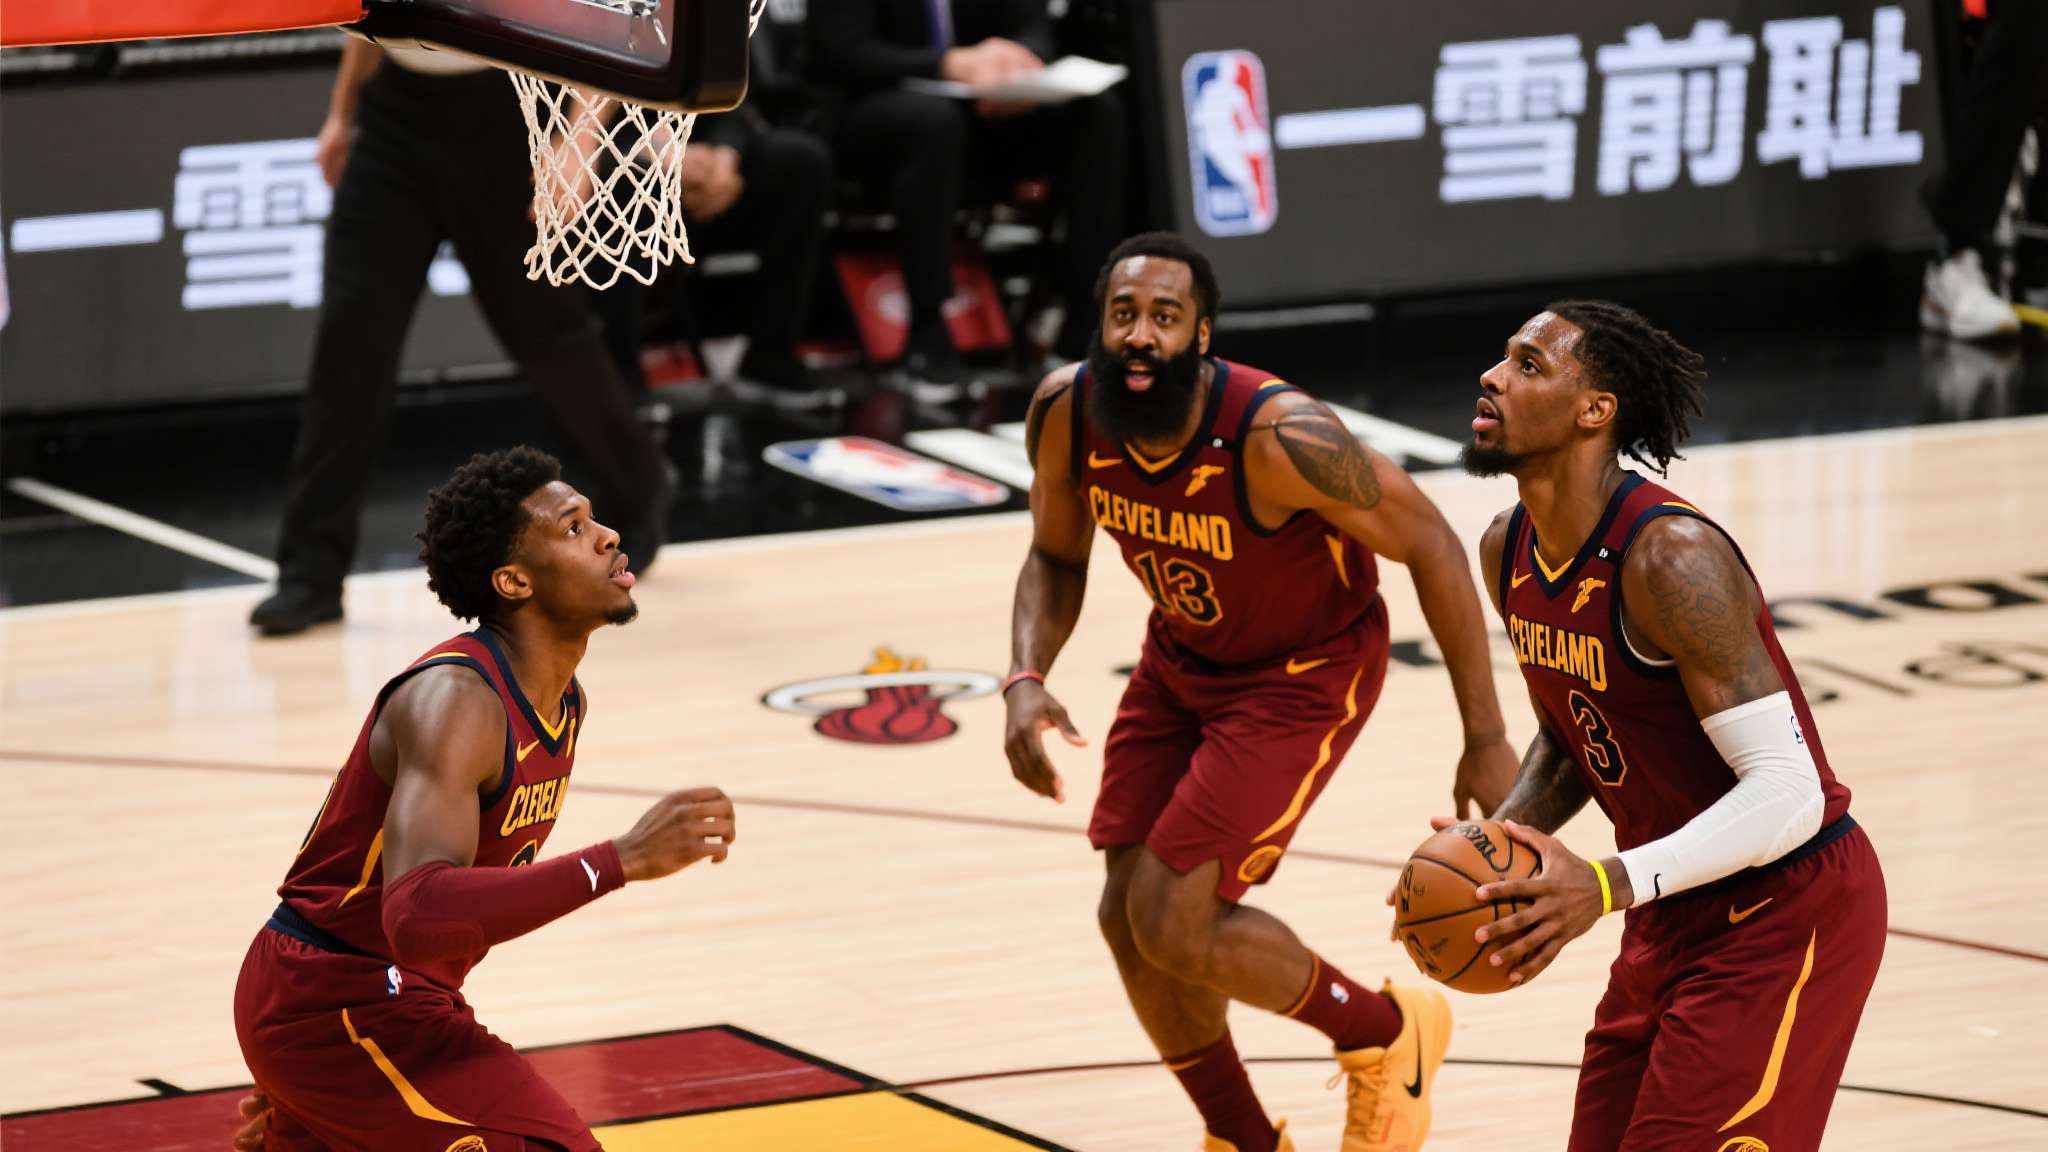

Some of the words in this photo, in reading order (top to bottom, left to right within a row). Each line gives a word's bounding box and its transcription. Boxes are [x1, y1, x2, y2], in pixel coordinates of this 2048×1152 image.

[1274, 5, 1923, 204] 一雪前耻
[12, 137, 471, 310] 一雪
[1089, 485, 1233, 561] CLEVELAND
[1133, 550, 1223, 626] 13
[1569, 689, 1628, 786] 3
